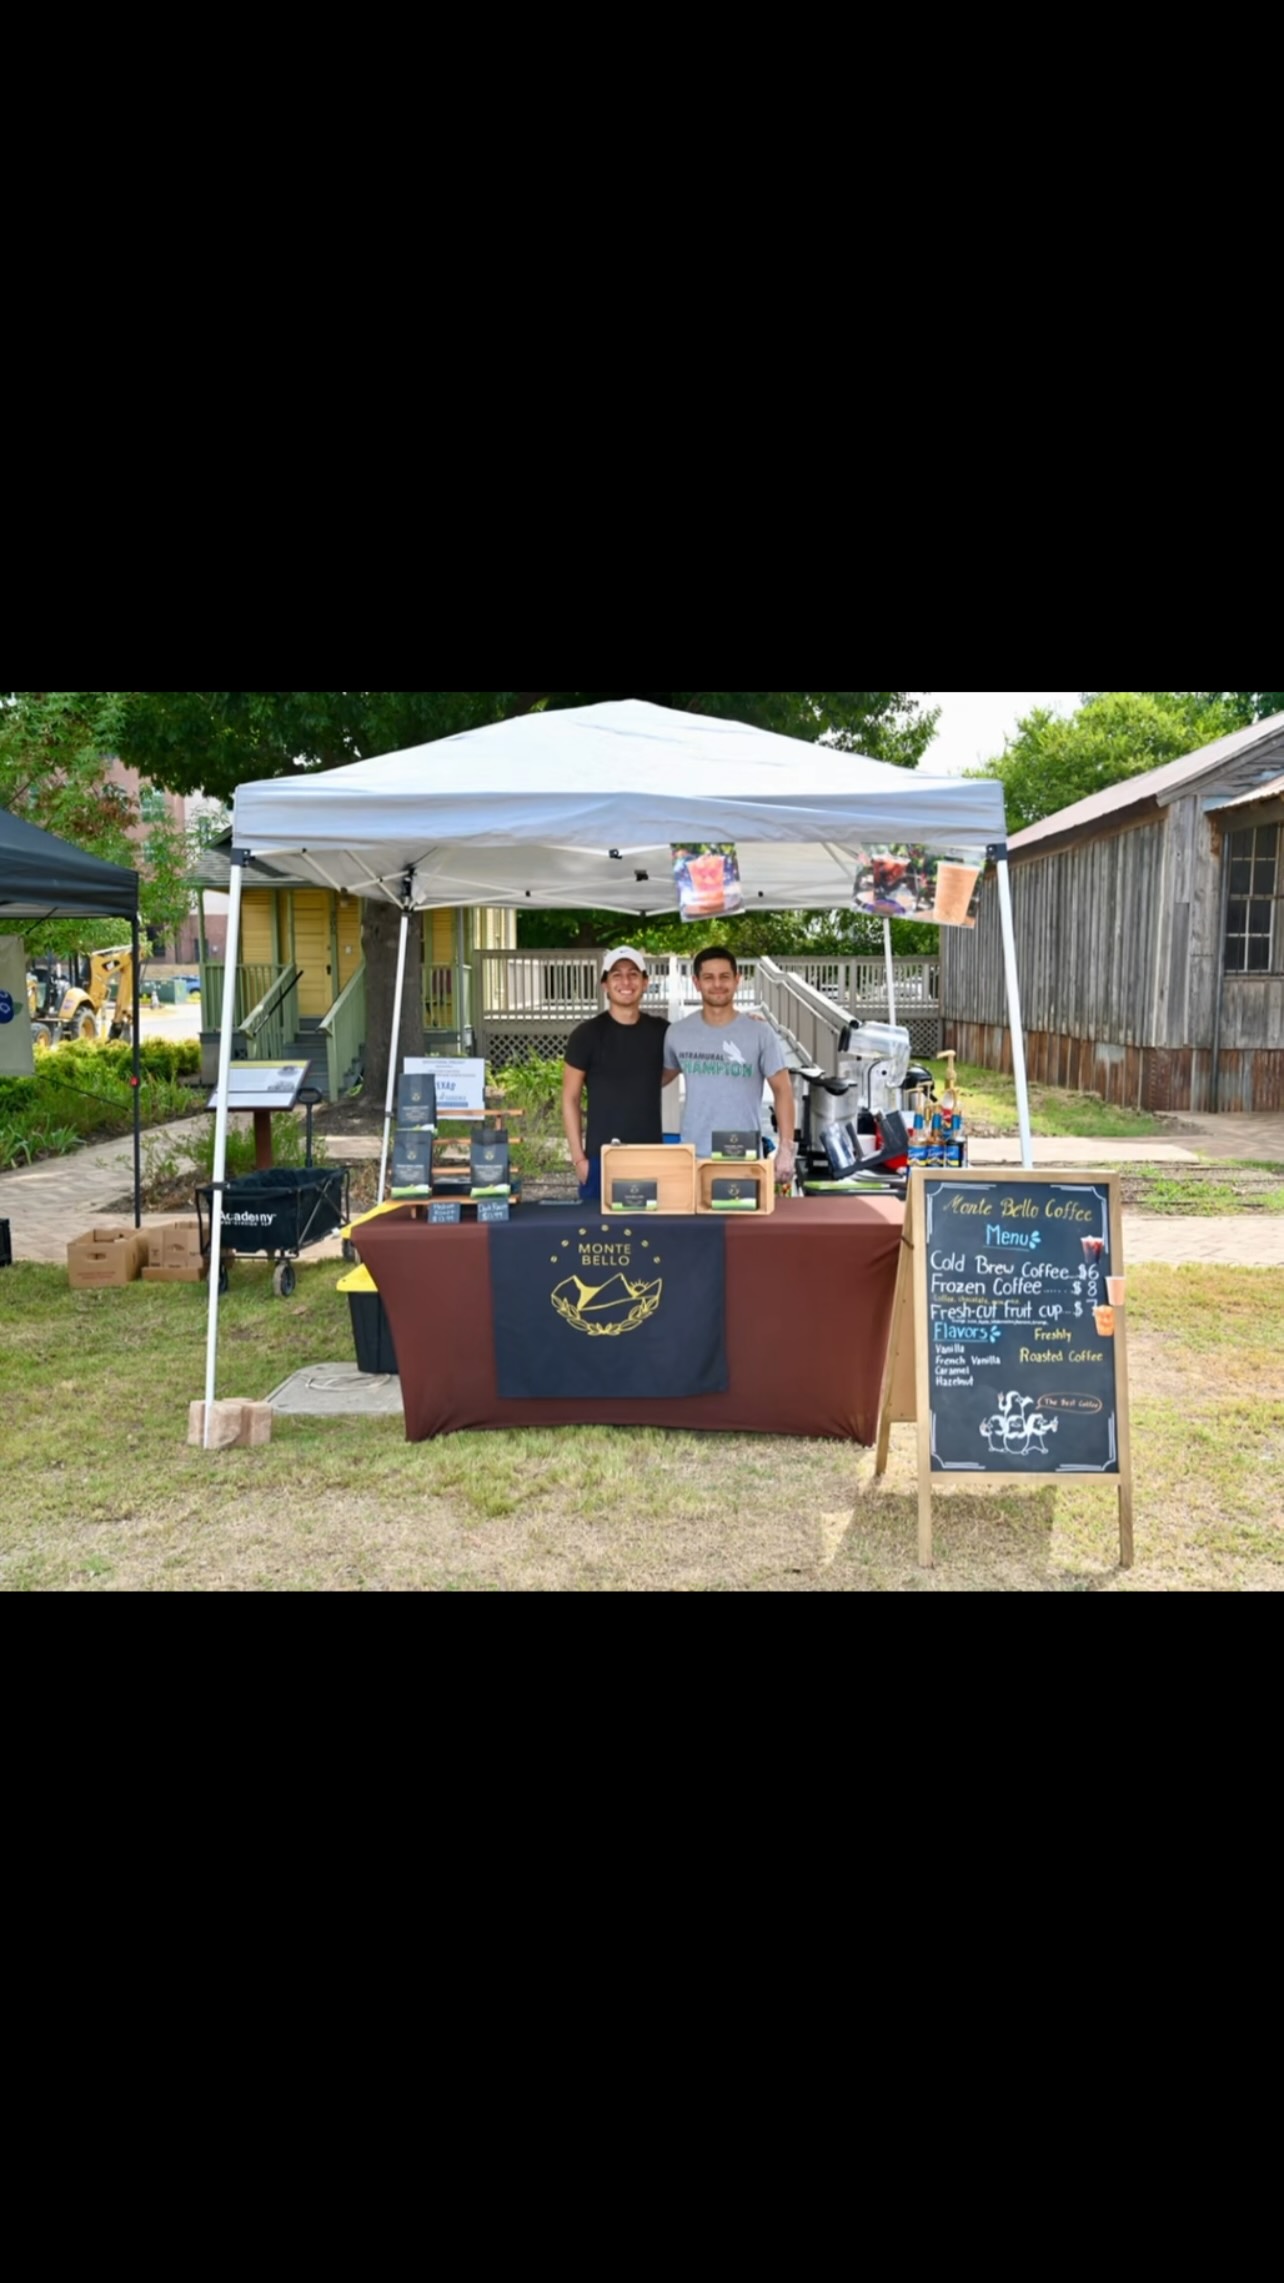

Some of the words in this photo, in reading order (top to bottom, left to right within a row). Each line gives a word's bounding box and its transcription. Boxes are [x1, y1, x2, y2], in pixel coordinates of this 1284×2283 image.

[681, 1059, 753, 1077] HAMPION
[942, 1194, 992, 1215] Monte
[1000, 1196, 1039, 1218] Bello
[1045, 1198, 1093, 1221] Coffee
[986, 1224, 1029, 1246] Menu
[578, 1243, 631, 1254] MONTE
[581, 1255, 630, 1266] BELLO
[930, 1250, 965, 1272] Cold
[975, 1254, 1014, 1275] Brew
[931, 1272, 986, 1295] Frozen
[993, 1277, 1042, 1296] Coffee
[930, 1301, 997, 1320] Fresh-cut
[1038, 1304, 1063, 1321] cup
[933, 1321, 988, 1340] Flavors
[1034, 1327, 1072, 1342] Freshly
[935, 1343, 965, 1354] Vanilla
[1019, 1347, 1063, 1363] Roasted
[1068, 1350, 1103, 1363] Coffee
[935, 1354, 966, 1366] French
[971, 1355, 1001, 1366] Vanilla
[934, 1365, 970, 1376] Caramel
[935, 1375, 974, 1387] Hazelnut
